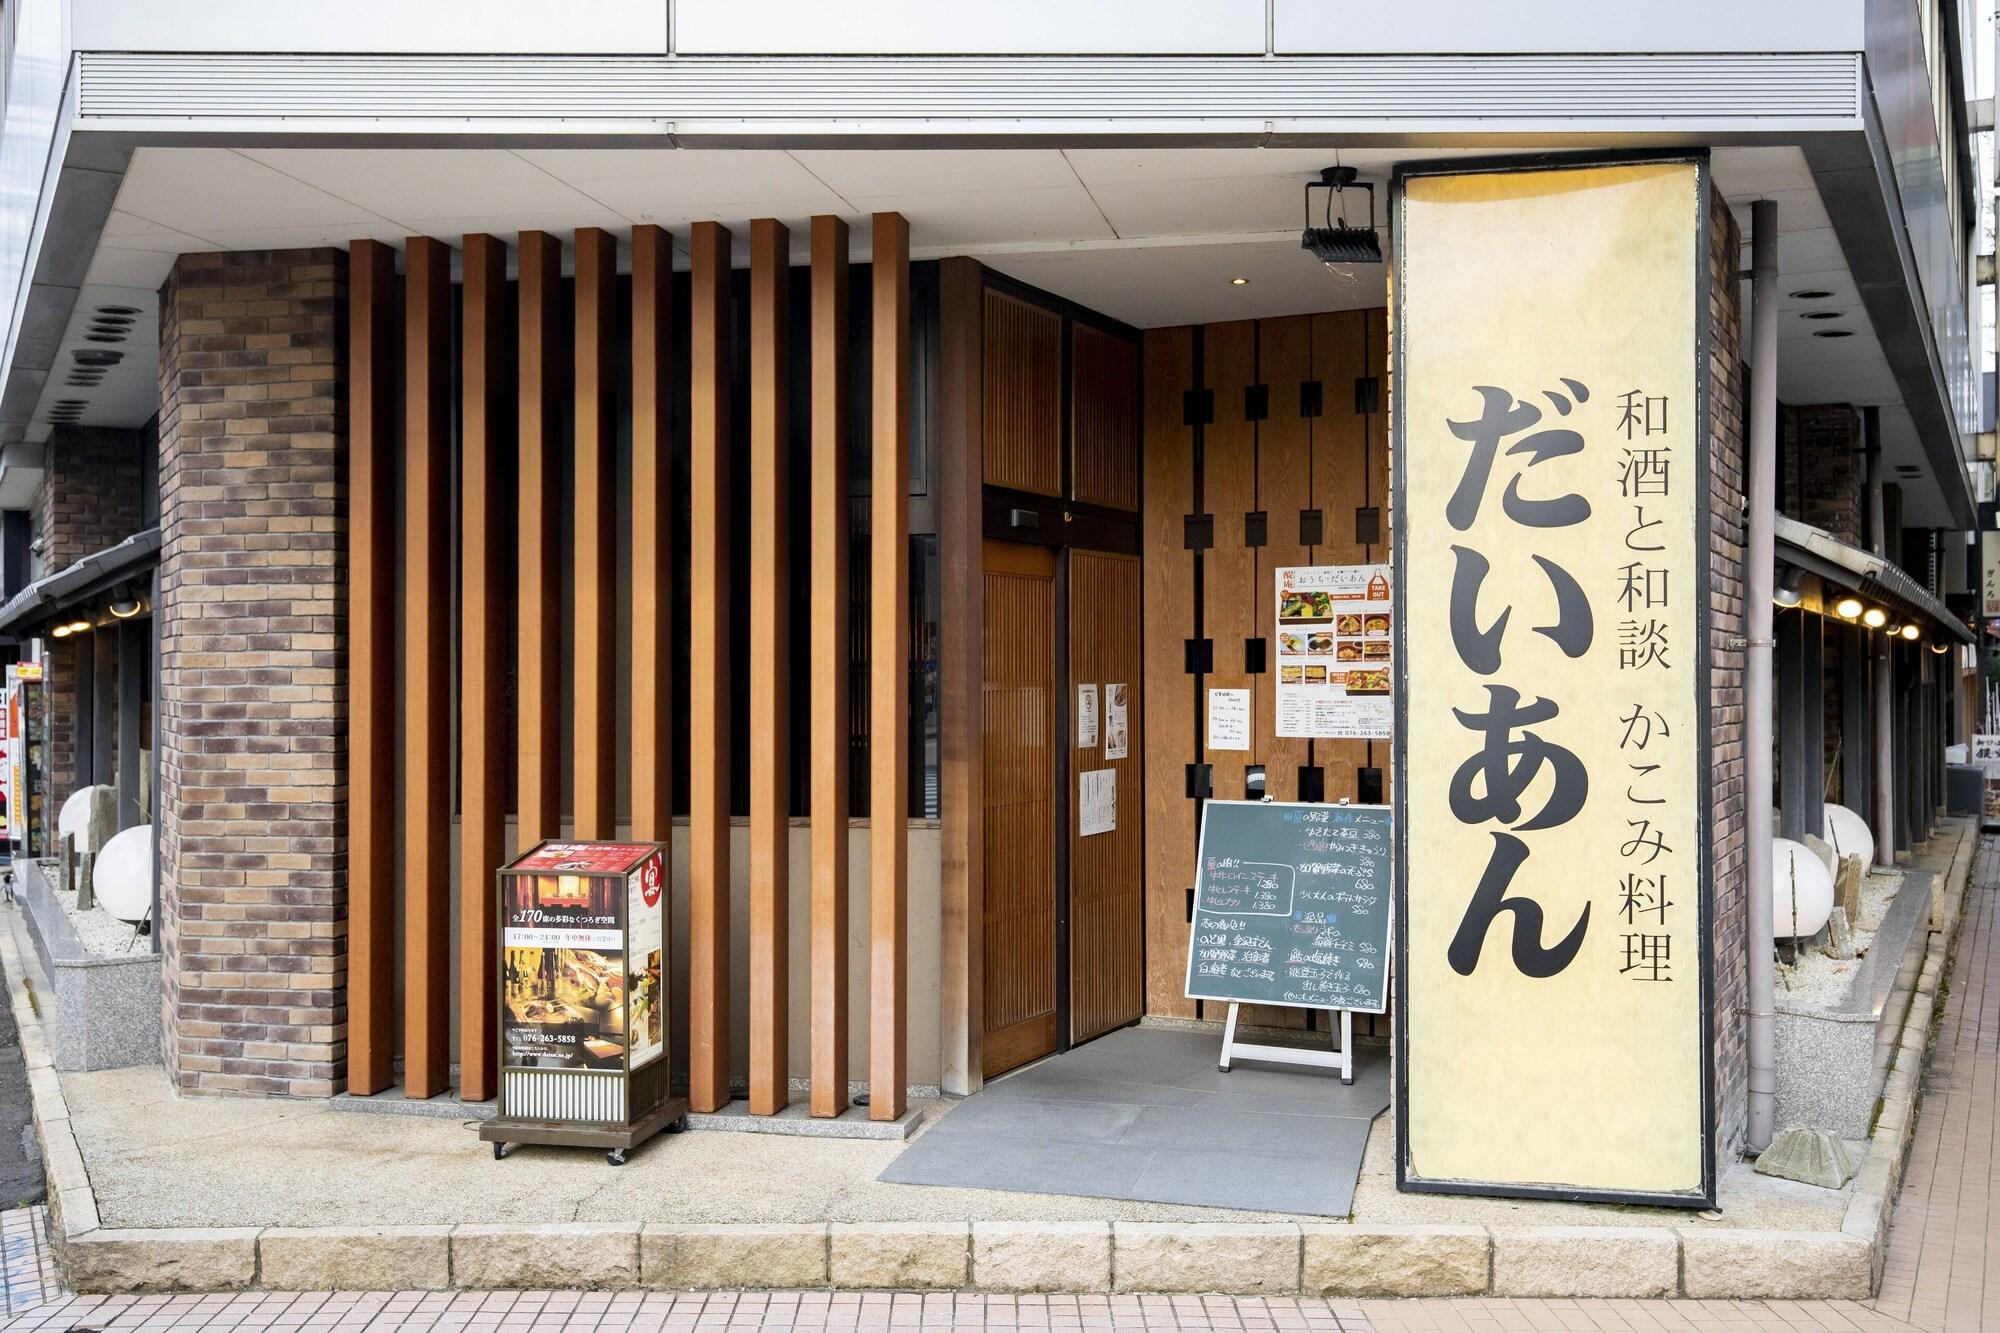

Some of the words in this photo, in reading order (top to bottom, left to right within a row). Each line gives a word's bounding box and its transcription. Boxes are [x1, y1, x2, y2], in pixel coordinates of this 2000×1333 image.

[1616, 389, 1672, 671] 和酒と和談
[1446, 377, 1594, 978] だいあん
[644, 858, 660, 898] 宴
[1618, 703, 1675, 982] かこみ料理
[523, 1033, 577, 1045] 076-263-5858
